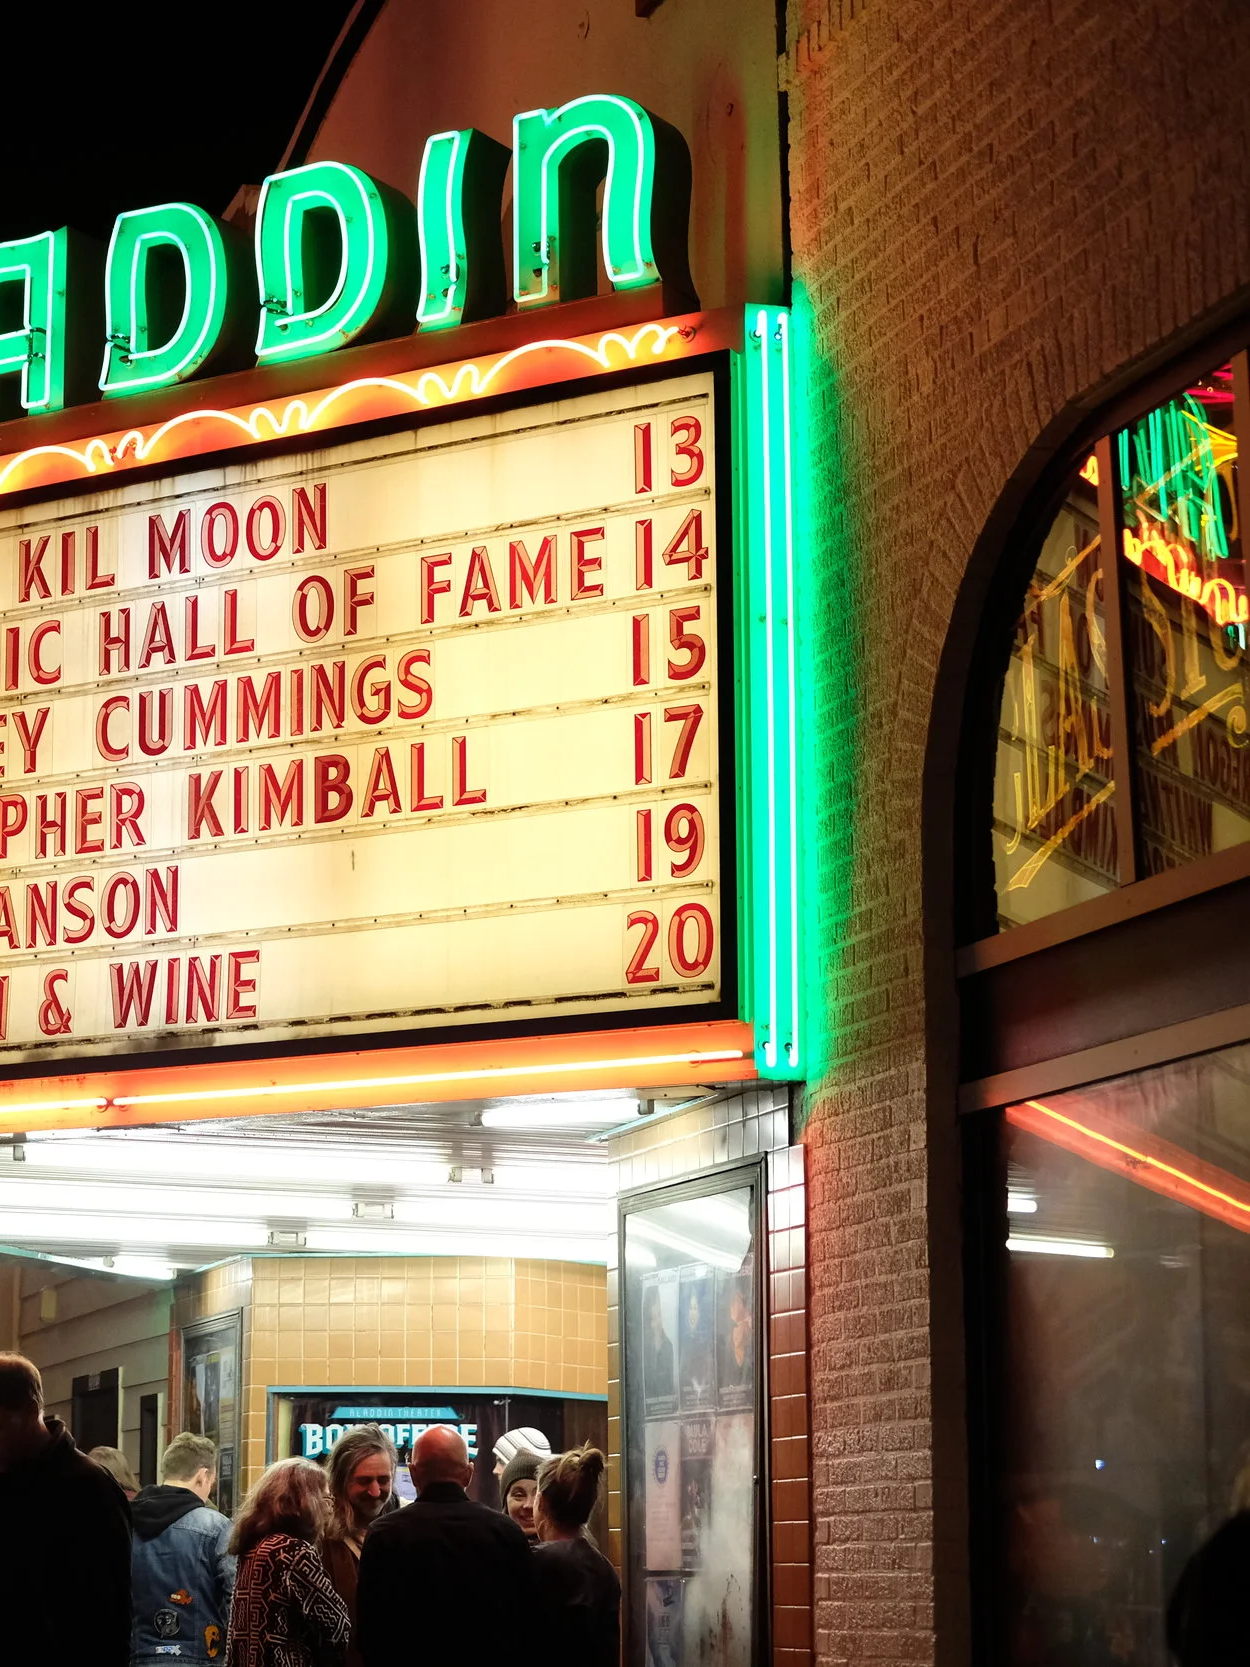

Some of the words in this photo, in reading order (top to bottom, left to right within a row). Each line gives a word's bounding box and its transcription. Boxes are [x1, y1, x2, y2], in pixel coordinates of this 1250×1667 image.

[18, 526, 115, 603] KIL
[148, 482, 327, 580] MOON
[634, 416, 704, 495] 13
[98, 588, 255, 676] HALL
[292, 564, 375, 643] OF
[420, 527, 606, 624] FAME
[635, 508, 709, 590] 14
[95, 648, 433, 762] CUMMINGS
[632, 606, 707, 686] 15
[187, 736, 487, 840] KIMBALL
[634, 704, 704, 785] 17
[636, 803, 706, 883] 19
[38, 968, 72, 1036] &
[109, 949, 260, 1029] WINE
[626, 902, 714, 984] 20
[299, 1423, 362, 1460] BO
